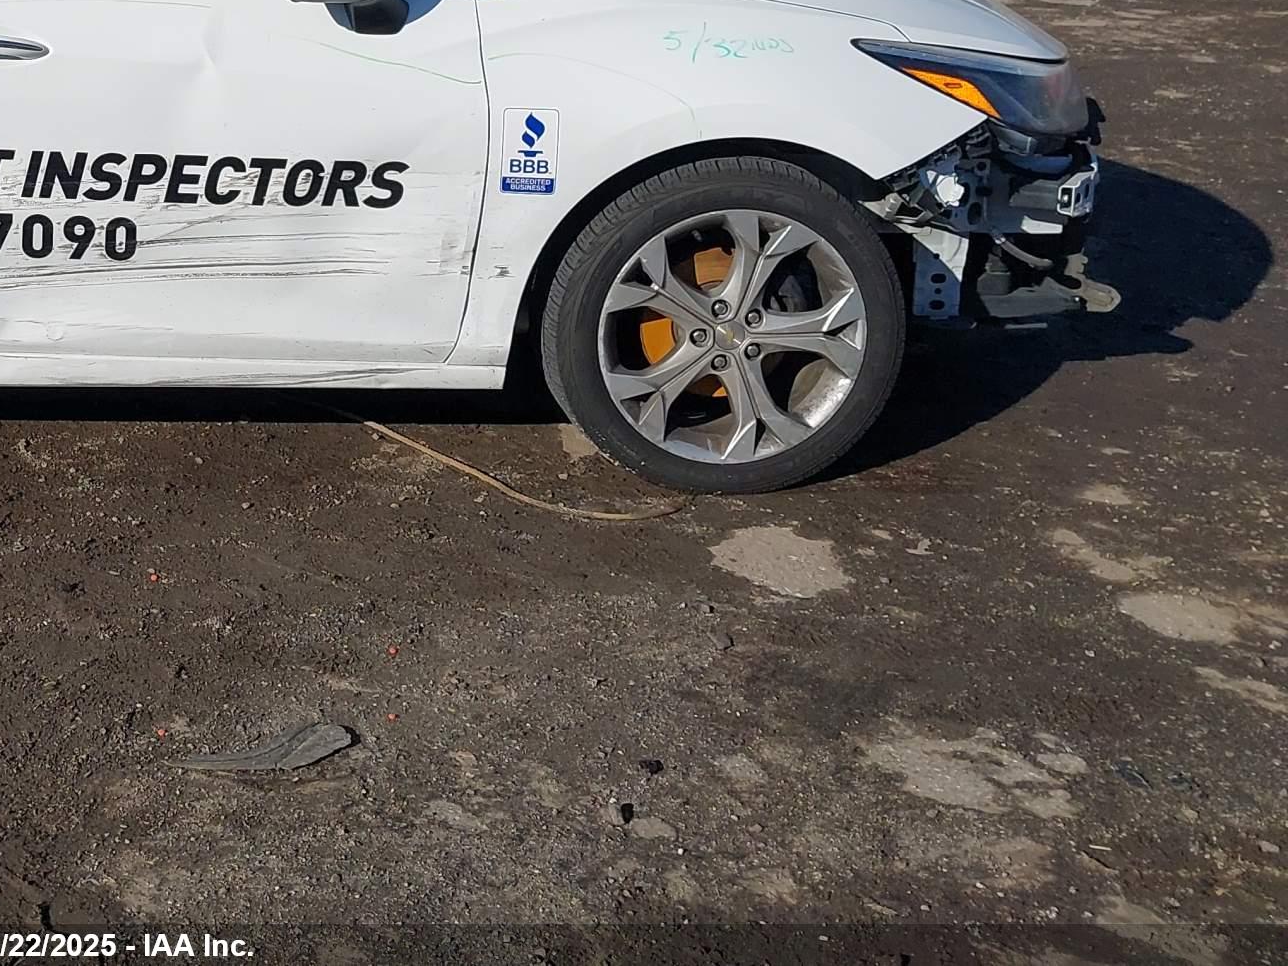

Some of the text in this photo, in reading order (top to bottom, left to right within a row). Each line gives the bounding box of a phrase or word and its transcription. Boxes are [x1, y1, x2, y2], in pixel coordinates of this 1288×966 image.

[509, 159, 549, 174] BBB
[20, 150, 412, 209] INSPECTORS
[506, 177, 551, 185] ACCREDITED
